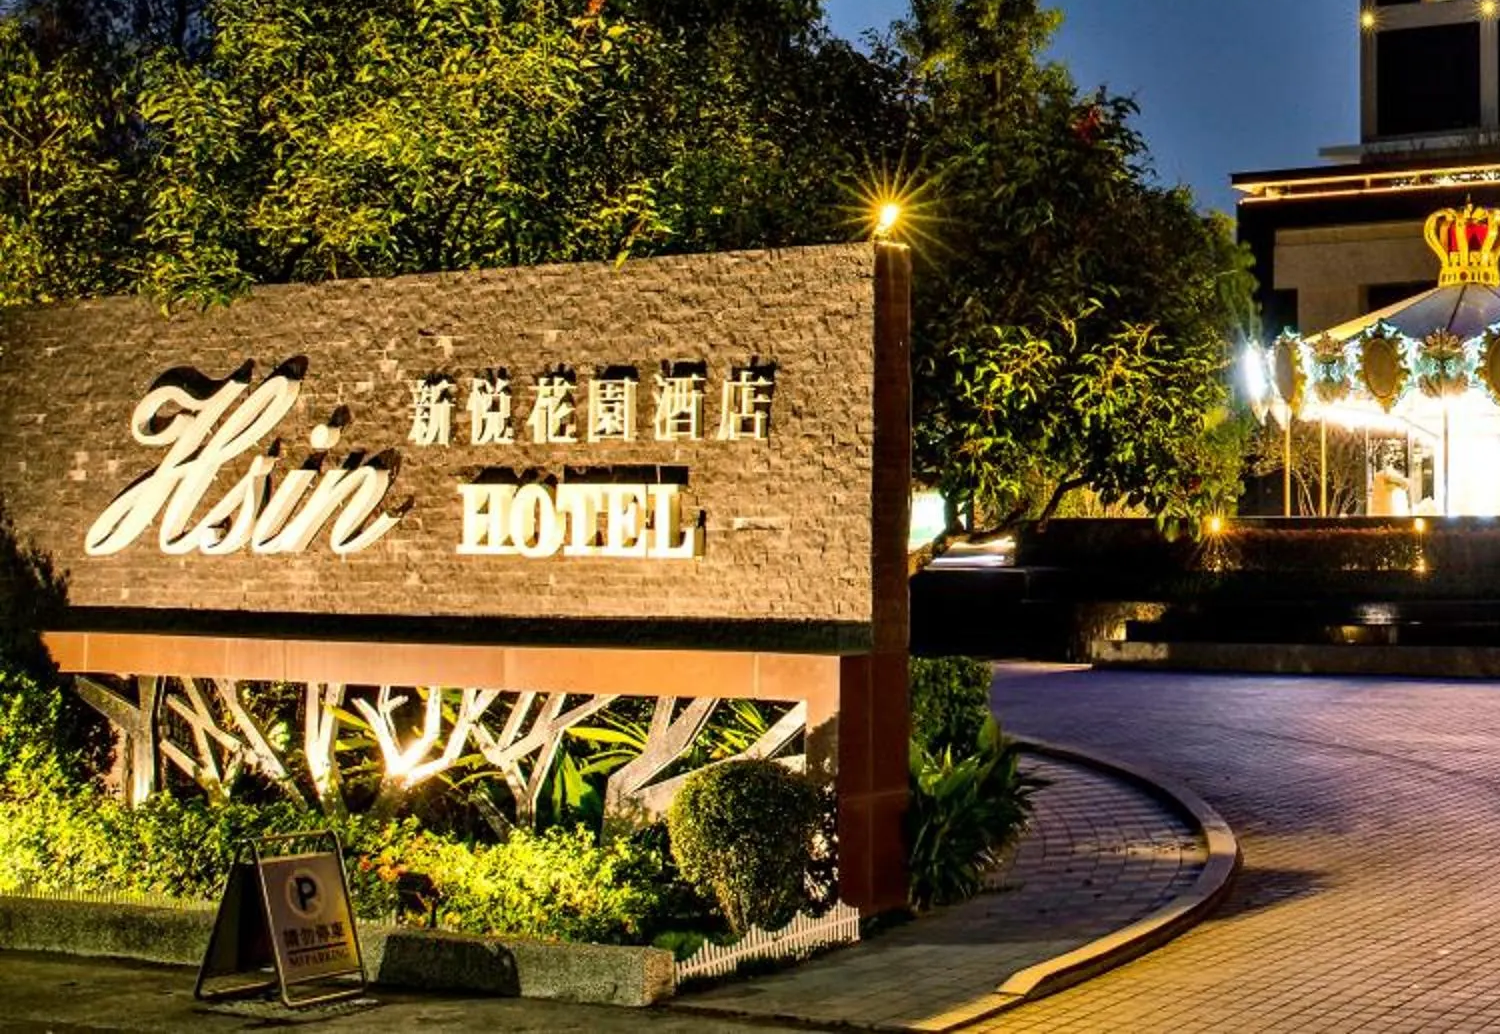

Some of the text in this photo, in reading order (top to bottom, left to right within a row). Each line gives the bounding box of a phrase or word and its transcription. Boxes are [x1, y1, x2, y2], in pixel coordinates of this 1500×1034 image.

[85, 374, 404, 557] Hsin
[456, 482, 696, 558] HOTEL
[295, 876, 317, 911] P
